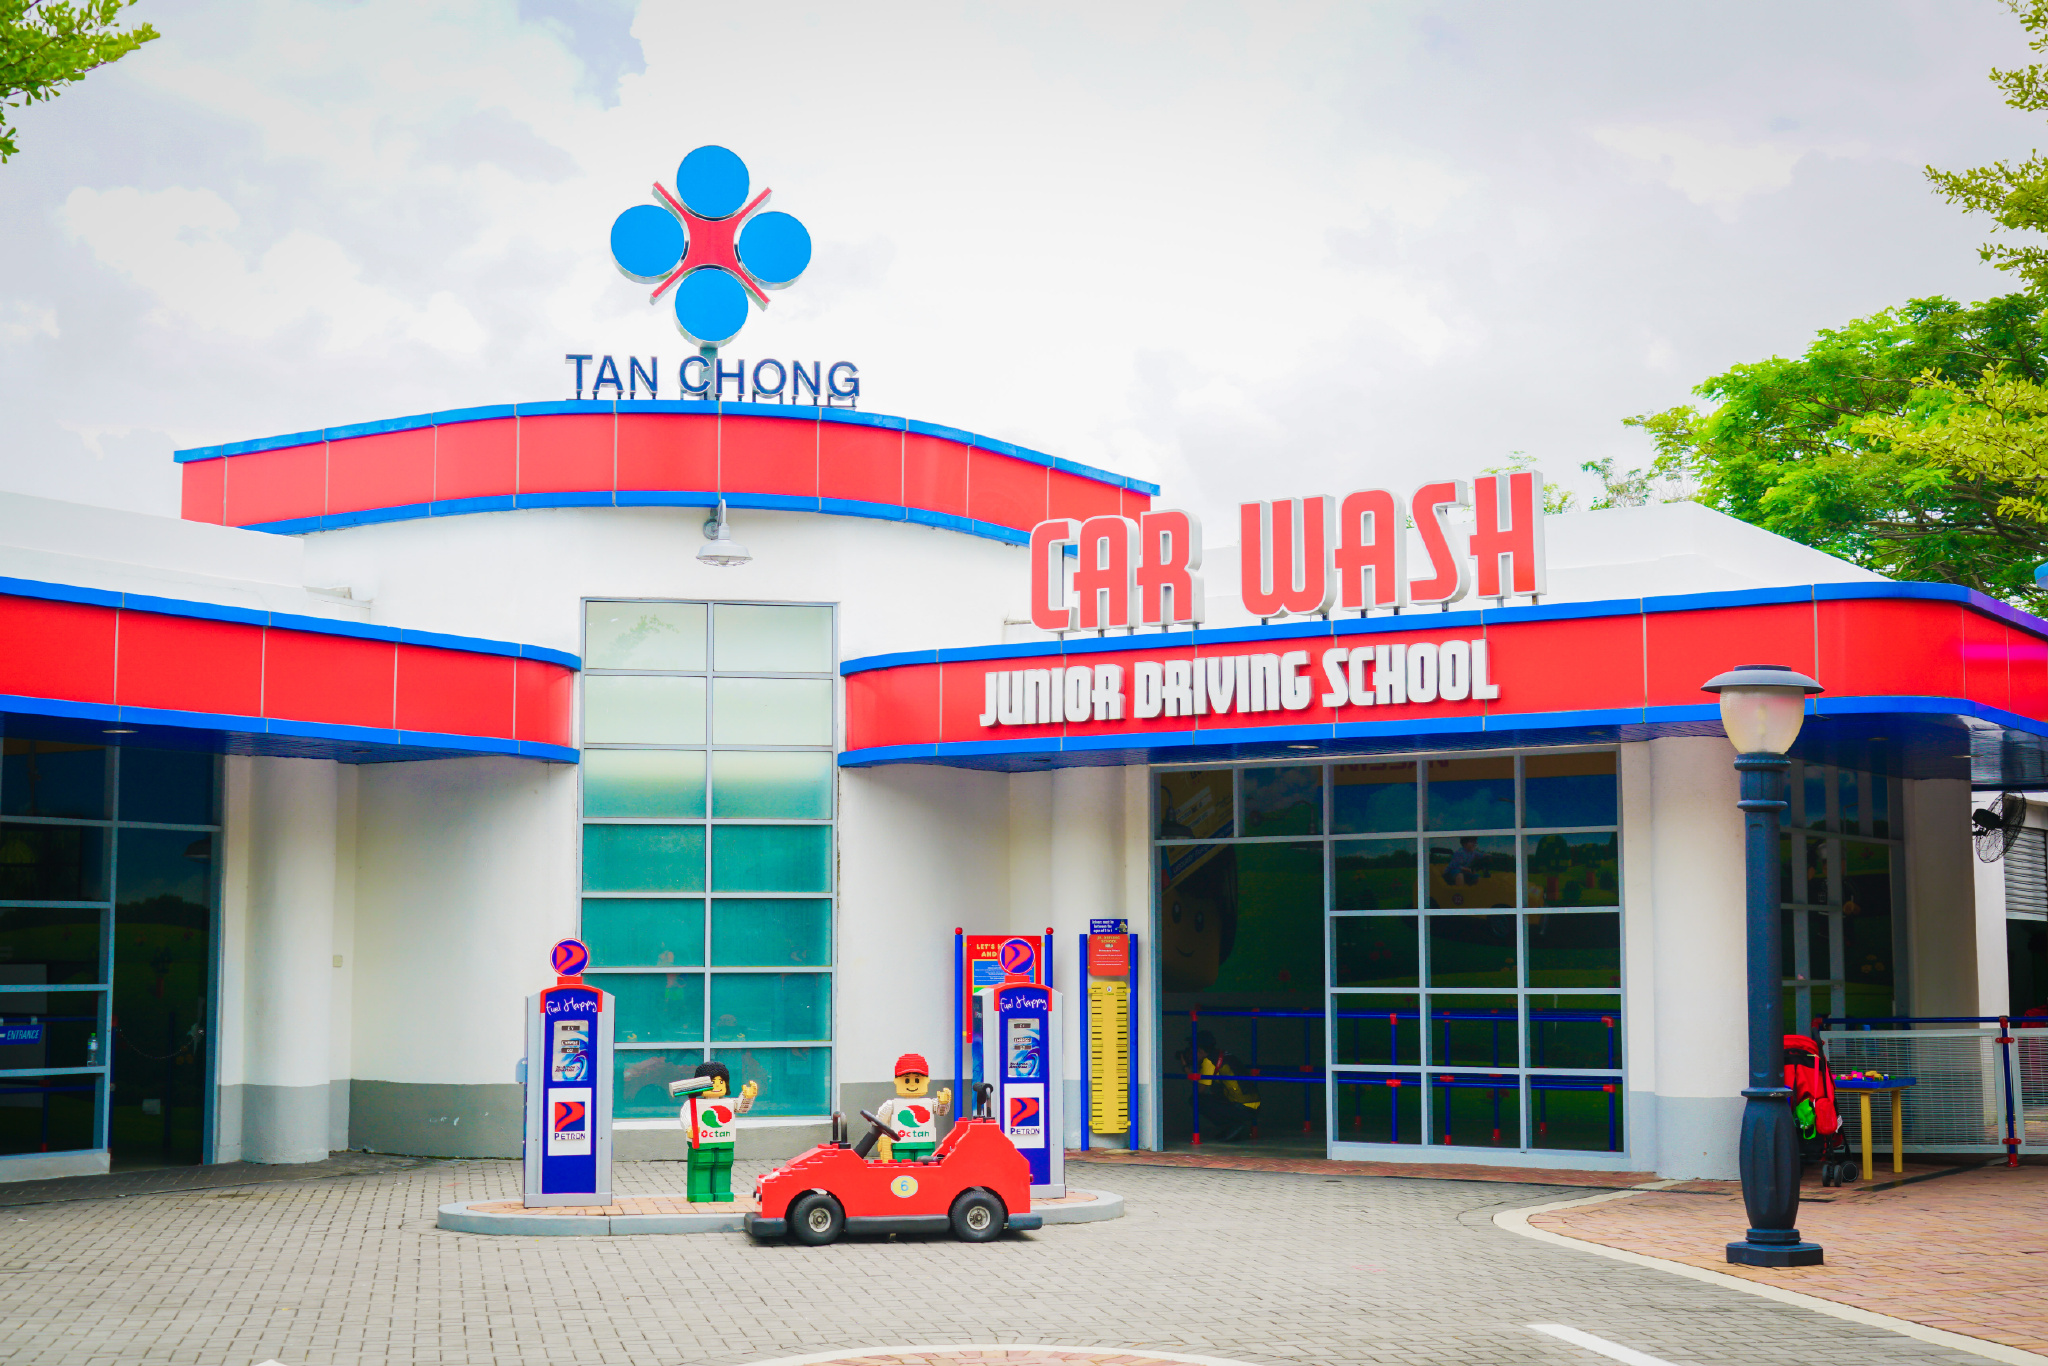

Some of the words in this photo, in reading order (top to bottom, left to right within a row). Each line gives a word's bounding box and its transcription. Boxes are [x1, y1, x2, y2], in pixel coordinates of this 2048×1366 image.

[565, 354, 658, 393] TAN
[679, 355, 860, 397] CHONG
[1030, 508, 1202, 633] CAR
[1239, 470, 1547, 618] WASH
[979, 663, 1126, 728] JUNIOR
[1133, 649, 1313, 718] DRIVING
[1322, 638, 1500, 708] SCHOOL
[563, 997, 597, 1013] Happy
[1016, 995, 1047, 1011] Happy
[7, 1029, 40, 1040] ENTRANCE
[554, 1132, 586, 1141] PETRON
[701, 1130, 731, 1138] Octan
[898, 1130, 930, 1138] Octan
[1010, 1127, 1040, 1135] PETRON
[900, 1180, 909, 1191] 6
